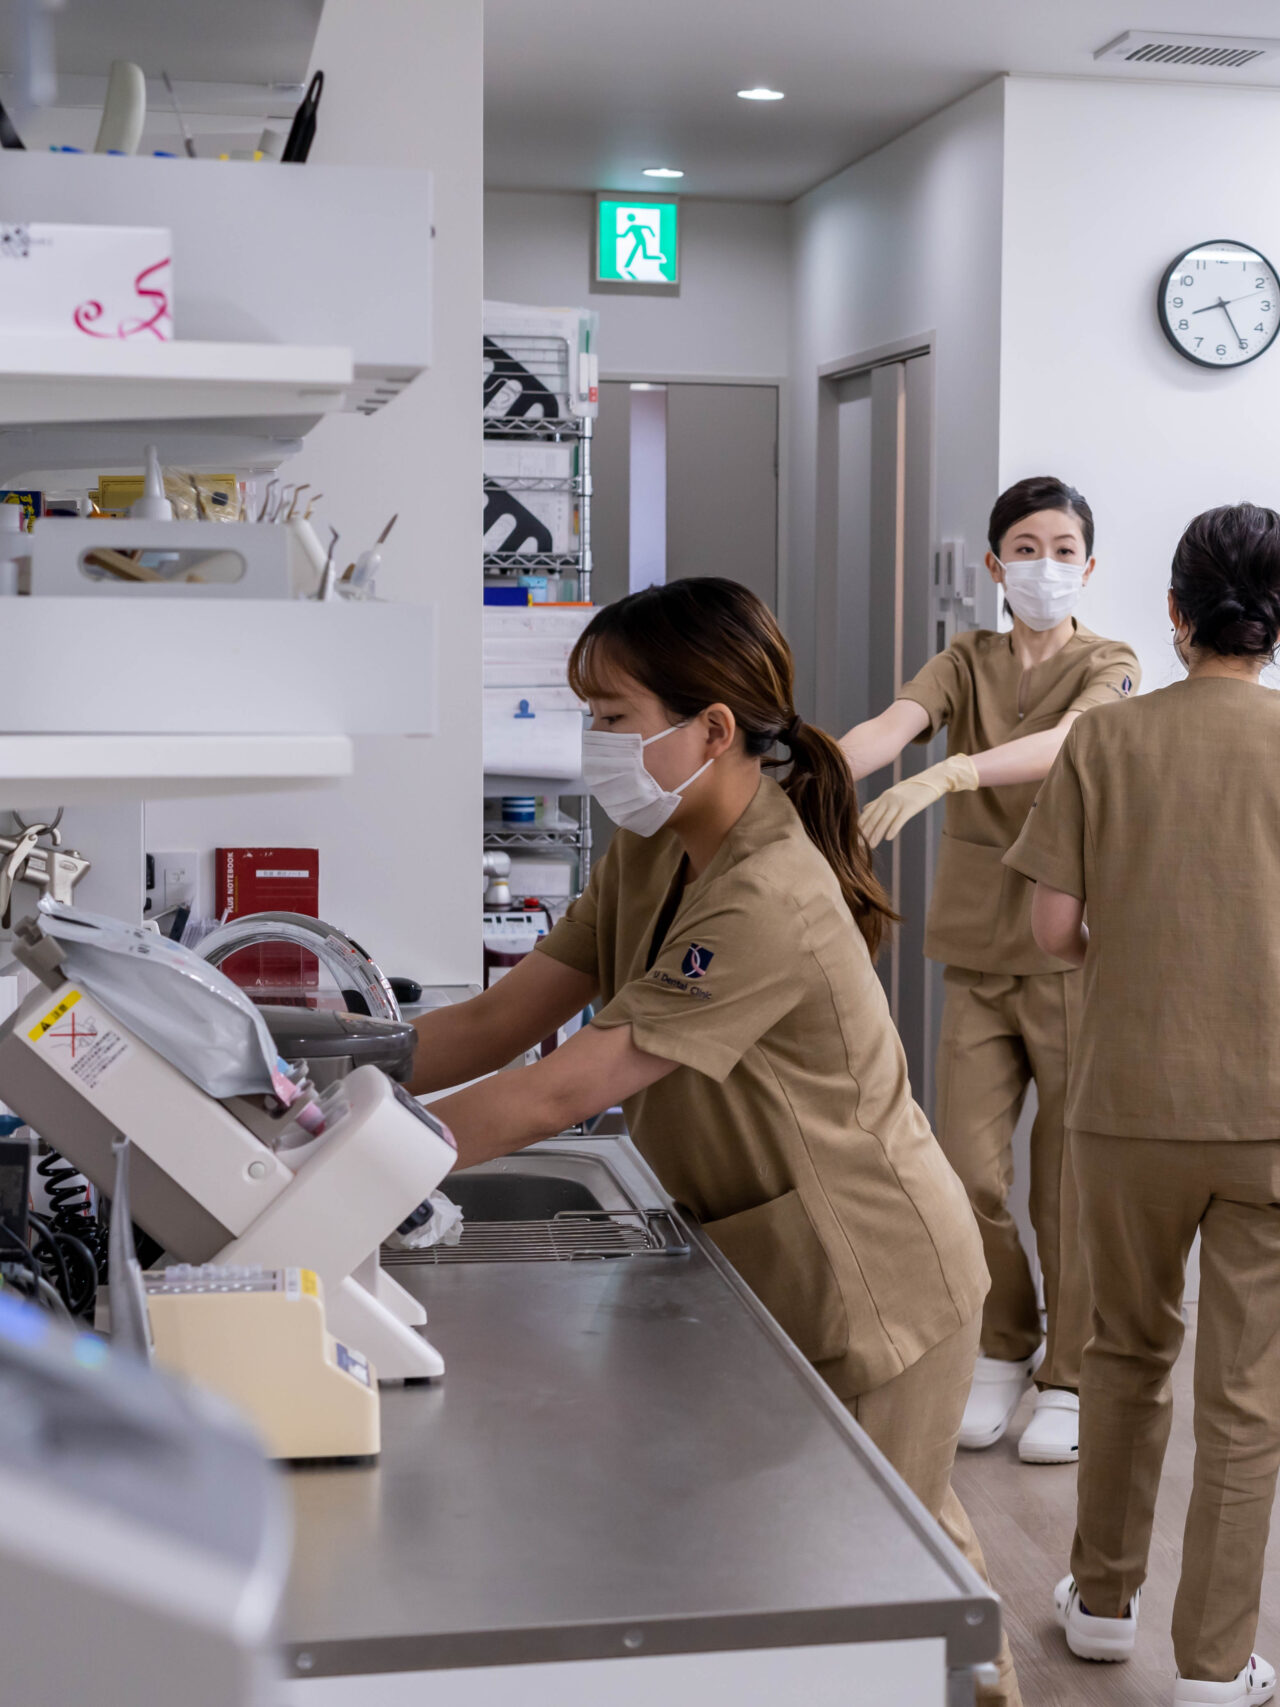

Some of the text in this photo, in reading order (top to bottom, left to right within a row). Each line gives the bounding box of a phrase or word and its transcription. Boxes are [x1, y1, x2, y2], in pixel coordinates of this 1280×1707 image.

[1180, 275, 1194, 286] 10
[1255, 278, 1265, 289] 2
[1173, 297, 1183, 308] 9
[1260, 300, 1271, 311] 3
[1178, 319, 1189, 330] 8
[1253, 322, 1264, 332] 4
[1194, 337, 1204, 348] 7
[1239, 339, 1248, 350] 5
[1216, 344, 1226, 356] 6
[661, 973, 688, 991] Dental
[690, 986, 712, 1000] Clinic
